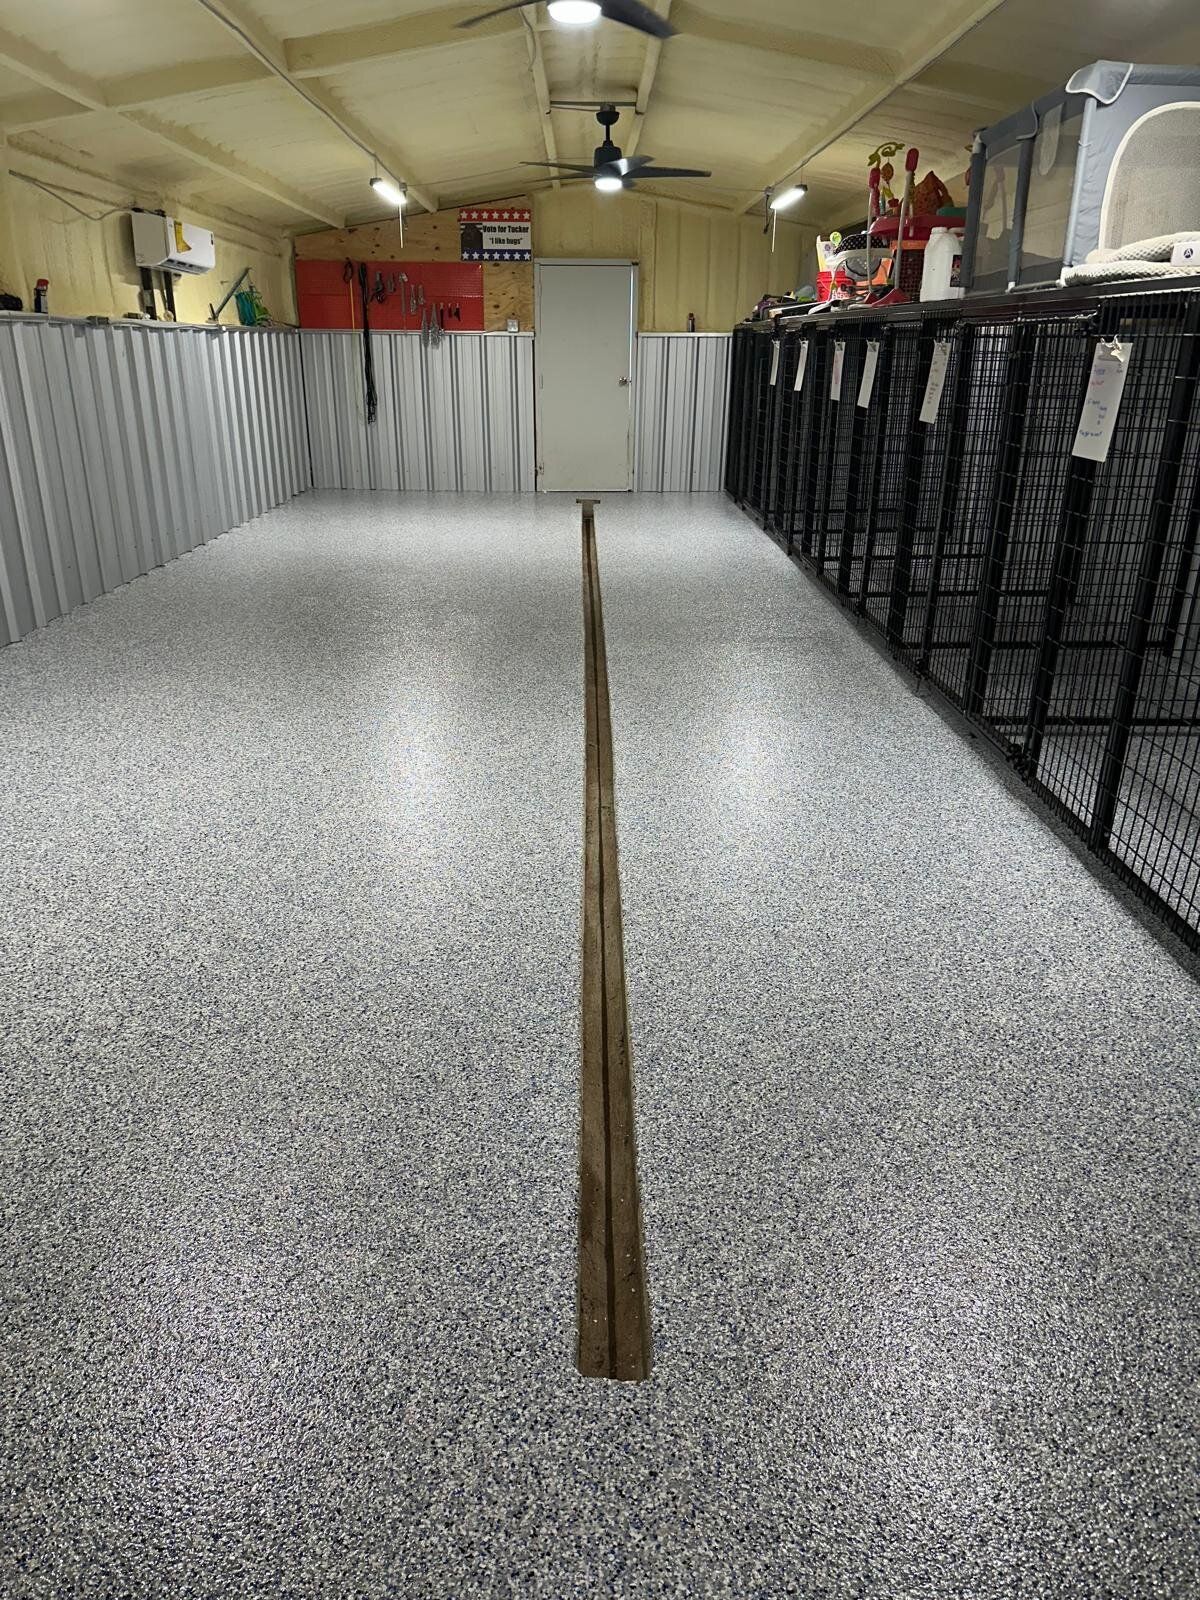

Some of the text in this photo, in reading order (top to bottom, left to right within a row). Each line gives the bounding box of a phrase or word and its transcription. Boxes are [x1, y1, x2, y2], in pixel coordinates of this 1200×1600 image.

[483, 225, 529, 233] Vote for Tucker
[495, 237, 505, 245] like
